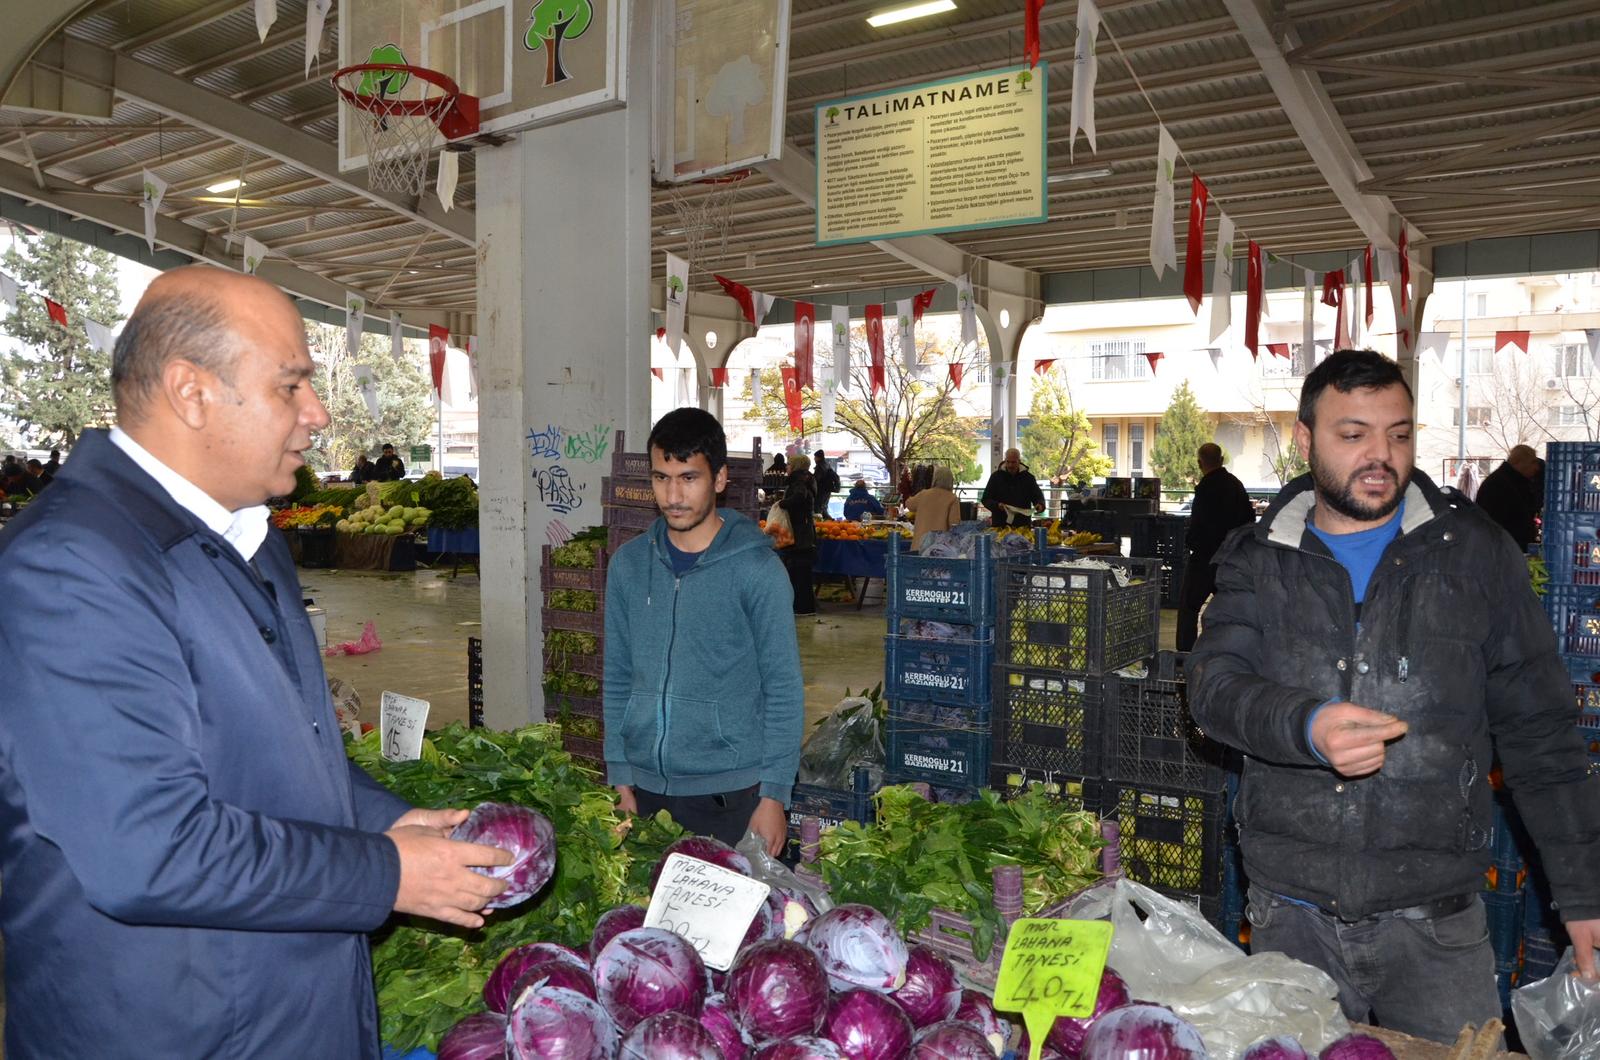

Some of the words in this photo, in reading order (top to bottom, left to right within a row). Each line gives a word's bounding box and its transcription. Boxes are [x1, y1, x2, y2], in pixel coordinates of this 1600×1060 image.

[905, 589, 951, 599] KEREMOGLU
[951, 591, 966, 605] 21
[904, 671, 950, 683] KEREMOGLU
[950, 677, 965, 690] 21
[386, 727, 401, 759] 15
[904, 753, 949, 766] KEREMOGLU
[950, 760, 964, 773] 21
[1011, 936, 1073, 950] LAHANA
